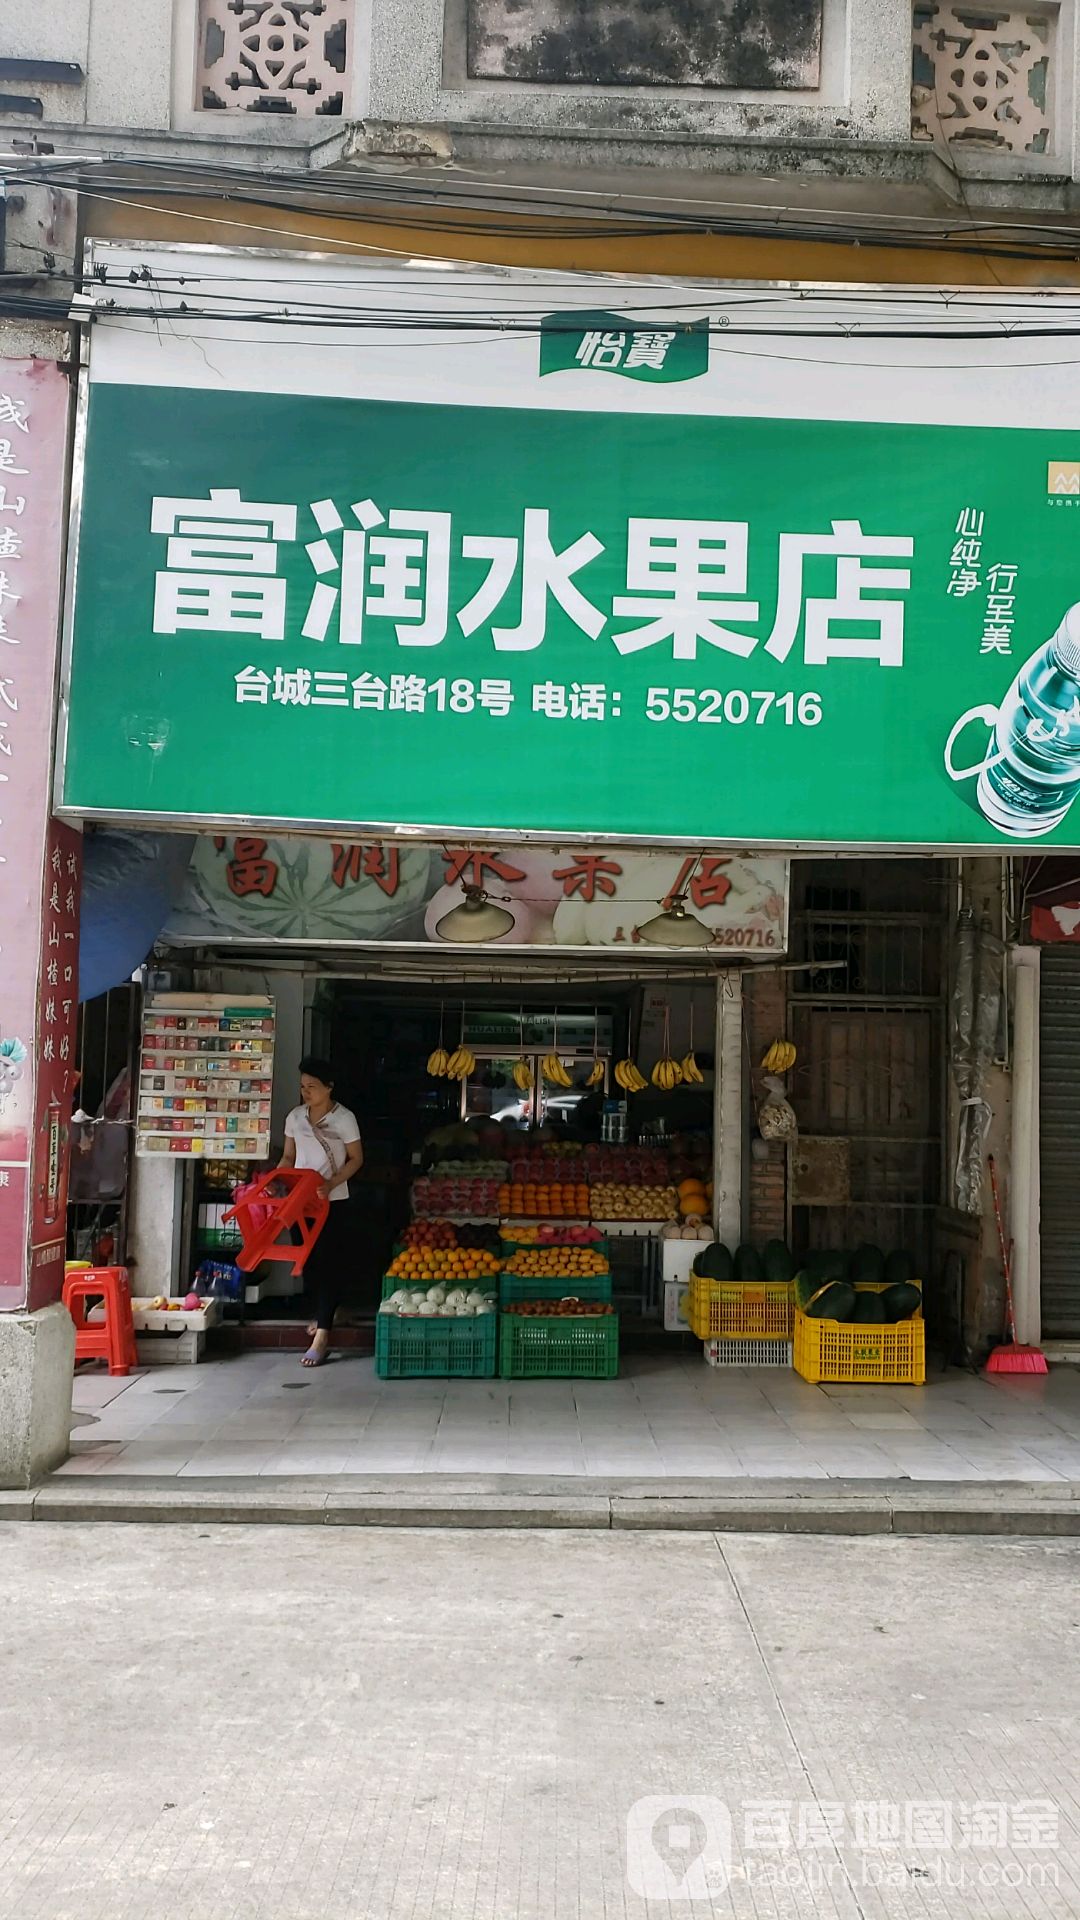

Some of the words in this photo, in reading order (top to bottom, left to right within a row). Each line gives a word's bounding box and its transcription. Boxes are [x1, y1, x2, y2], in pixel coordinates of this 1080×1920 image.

[150, 488, 914, 667] 富润水果店
[947, 507, 984, 597] 心纯净
[979, 563, 1018, 655] 行至美
[234, 665, 515, 718] 台城三台路18号
[709, 927, 776, 947] 520716
